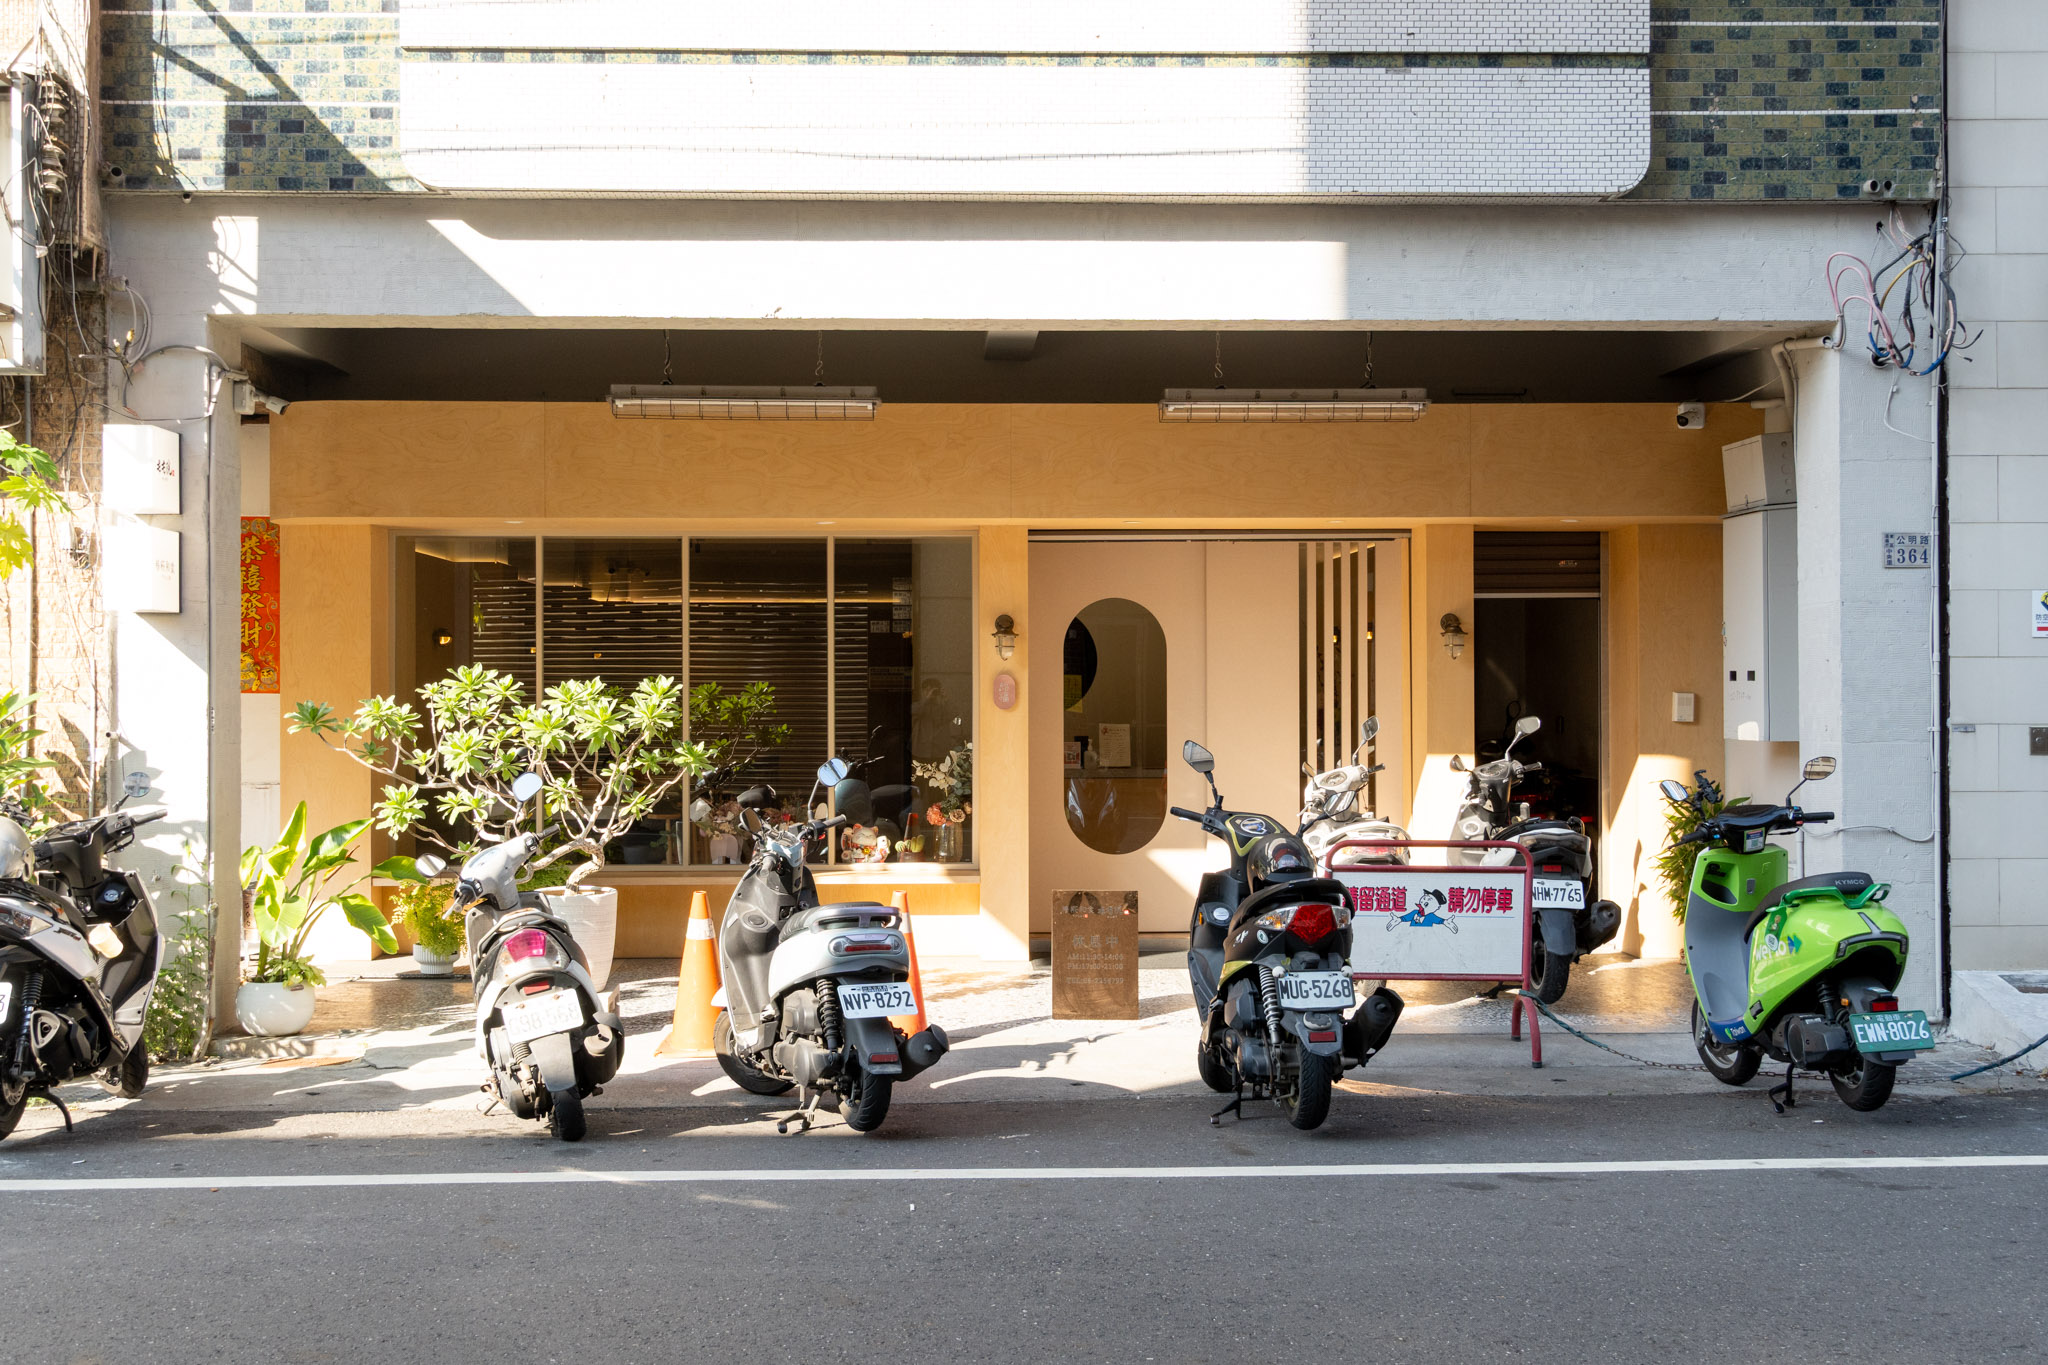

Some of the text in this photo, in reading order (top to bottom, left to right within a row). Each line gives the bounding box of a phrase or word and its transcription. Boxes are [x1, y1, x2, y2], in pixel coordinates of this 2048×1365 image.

[1896, 535, 1929, 545] 公明路
[1896, 548, 1929, 564] 364
[1447, 886, 1514, 914] 請勿停車
